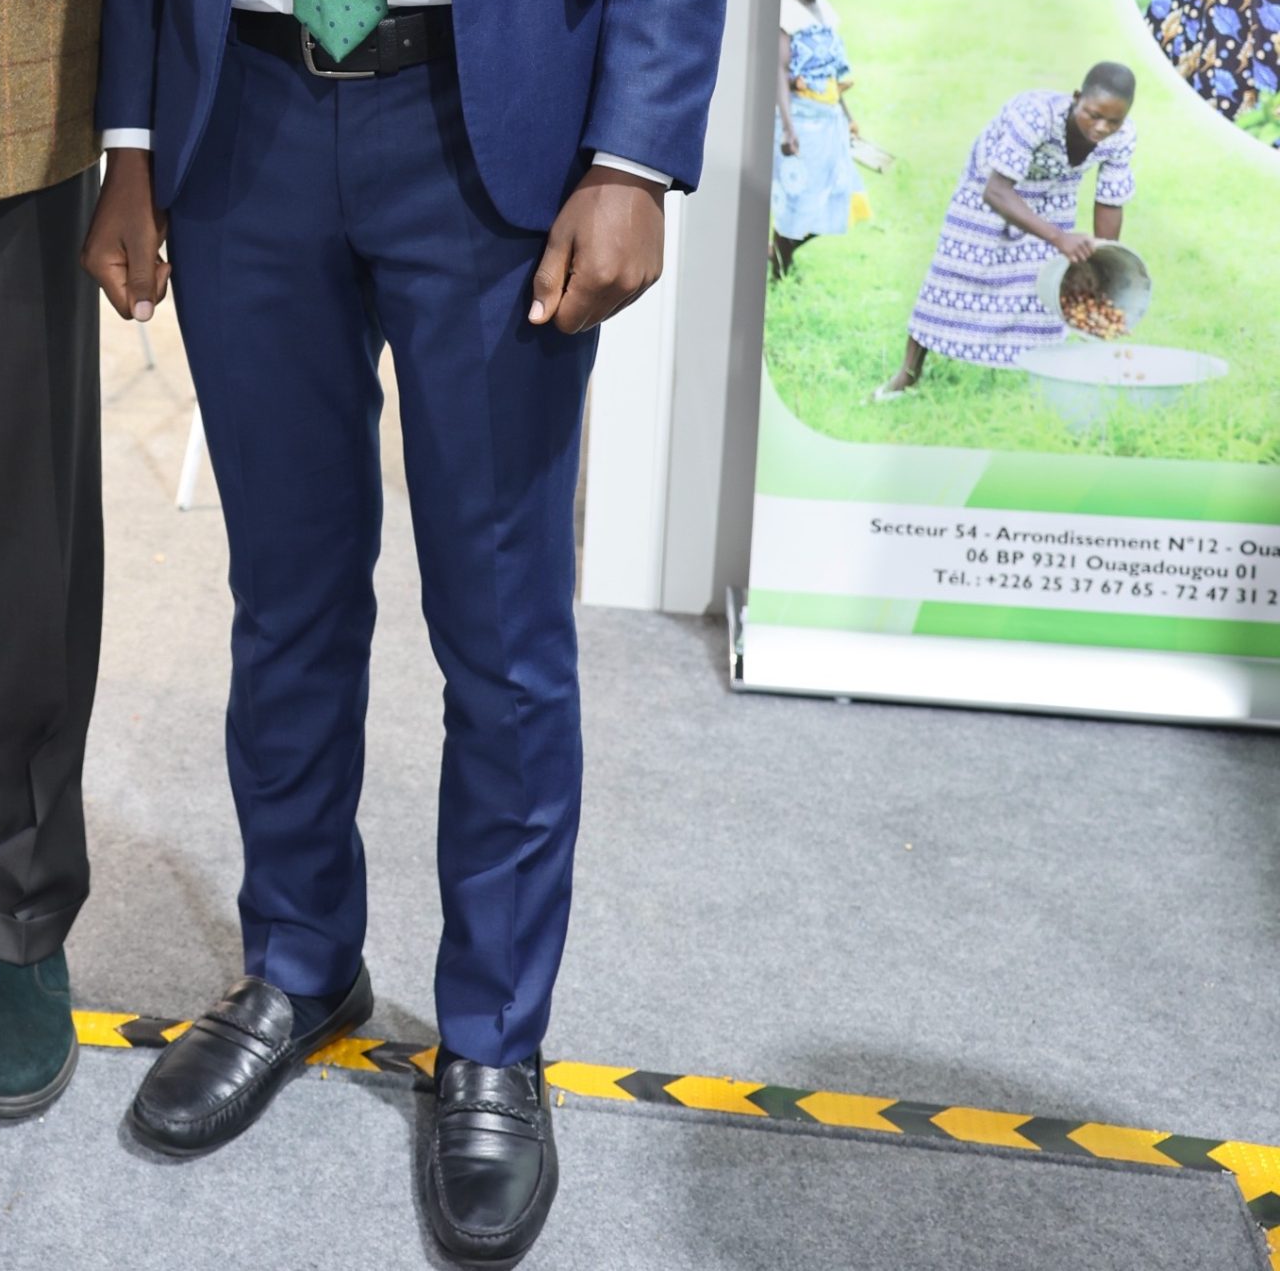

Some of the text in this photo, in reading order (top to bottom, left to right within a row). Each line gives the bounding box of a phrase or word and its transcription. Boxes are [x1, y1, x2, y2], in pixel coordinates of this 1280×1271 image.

[869, 517, 948, 538] Secteur
[955, 524, 977, 539] 54
[995, 526, 1161, 551] Arrondissement
[965, 548, 1256, 581] 06 BP 9321 Ouagadougou 01
[987, 573, 1033, 590] +226
[1041, 576, 1062, 591] 25
[1070, 578, 1093, 593] 37
[1100, 580, 1124, 596] 67
[1131, 582, 1153, 598] 65
[1175, 585, 1198, 601] 72
[1206, 587, 1229, 601] 47
[1236, 588, 1257, 604] 31
